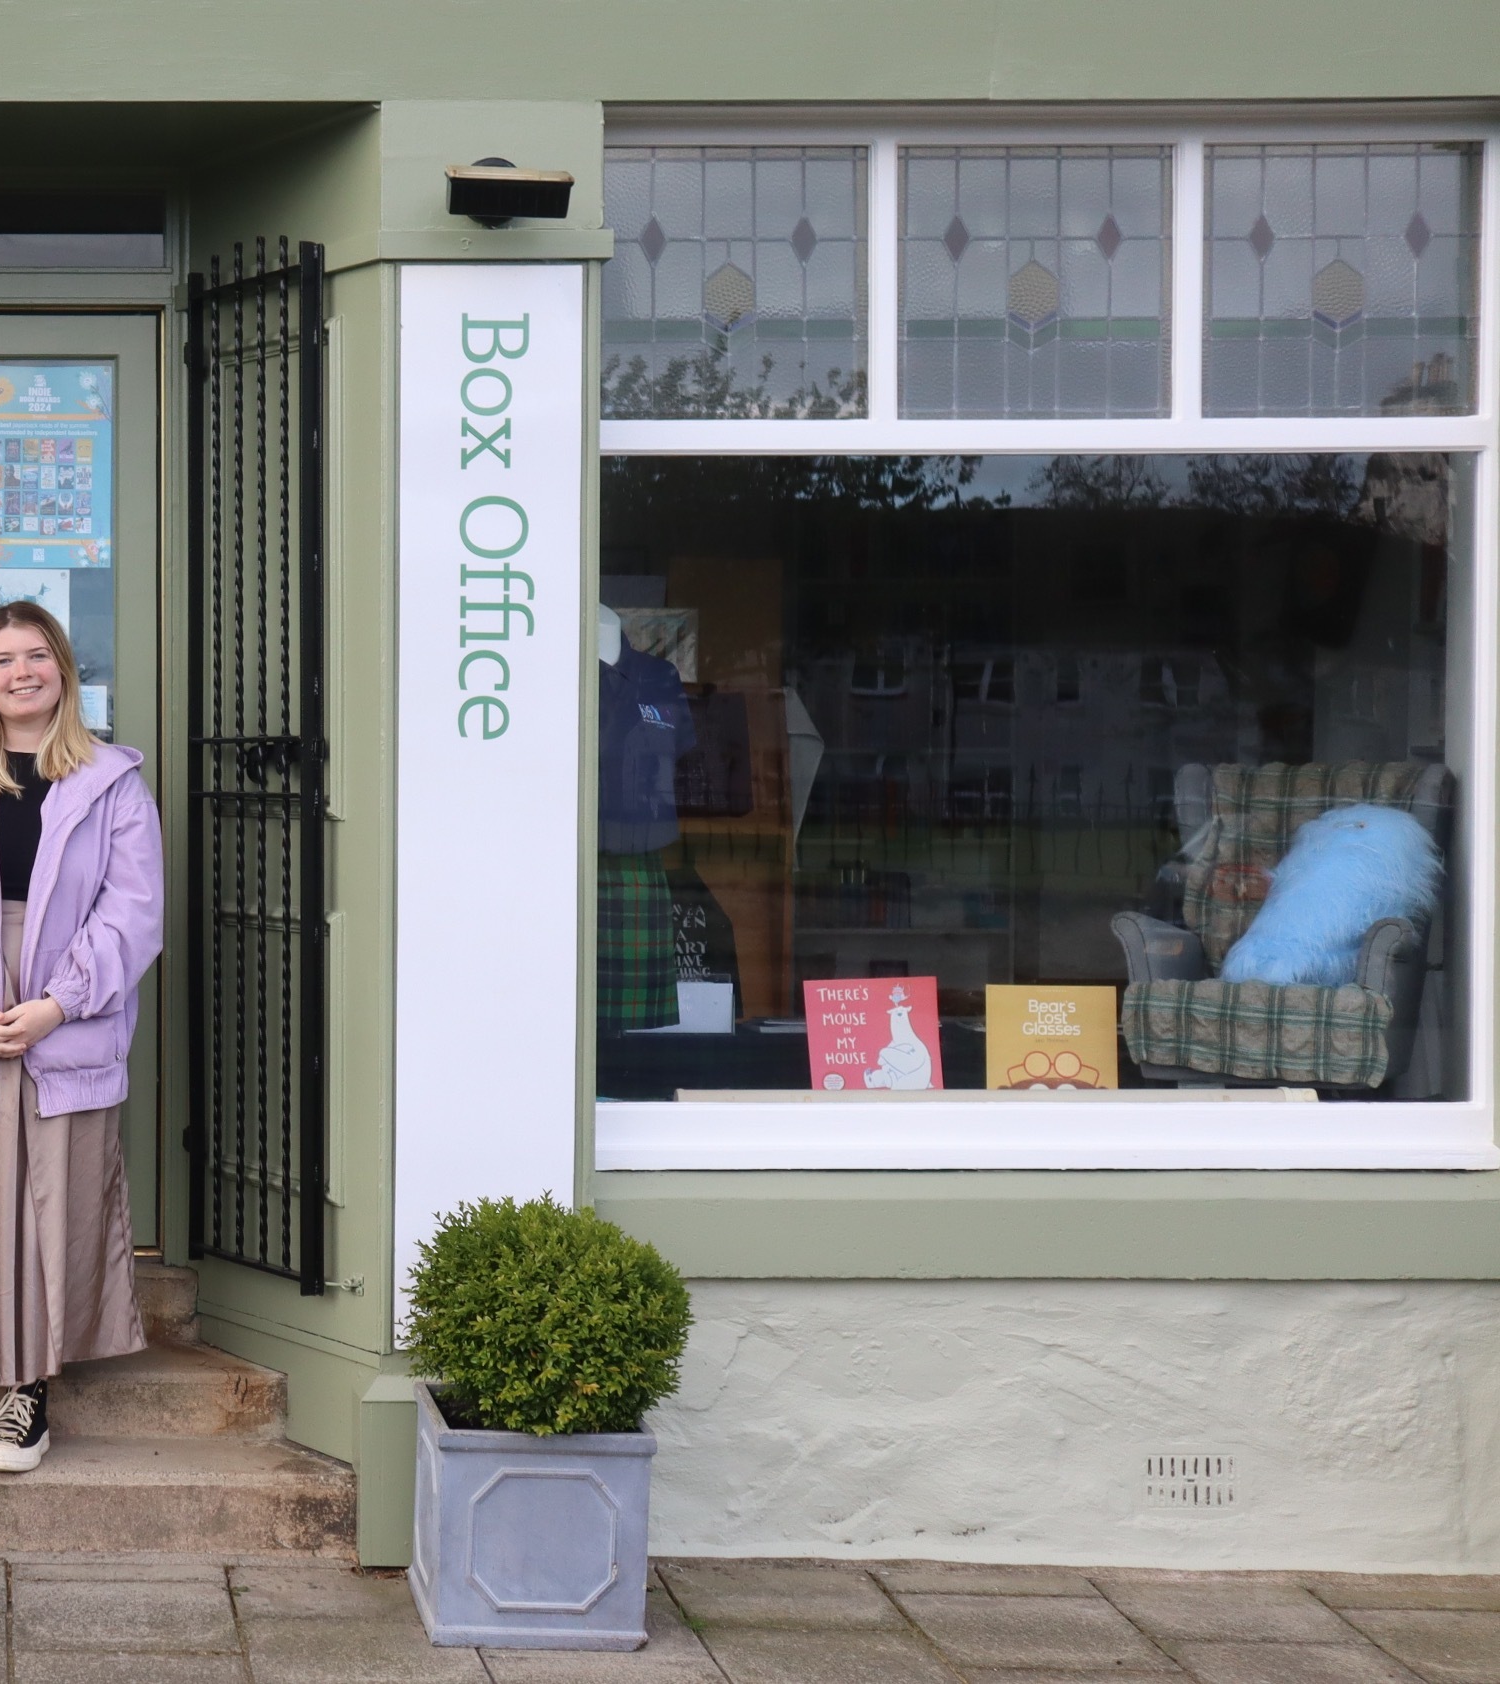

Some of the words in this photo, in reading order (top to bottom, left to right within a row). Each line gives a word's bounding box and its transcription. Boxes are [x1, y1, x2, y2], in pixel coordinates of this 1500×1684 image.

[28, 388, 52, 396] INDIE
[460, 312, 530, 470] Box
[28, 404, 52, 412] 2024
[458, 495, 535, 741] Office
[674, 941, 708, 954] ARY
[816, 985, 869, 1002] THERE'S
[1028, 999, 1076, 1013] Bear's
[822, 1012, 867, 1026] MOUSE
[1038, 1012, 1068, 1025] Lost
[1022, 1022, 1081, 1036] Glasses
[837, 1037, 856, 1049] MY
[826, 1052, 867, 1065] HOUSE
